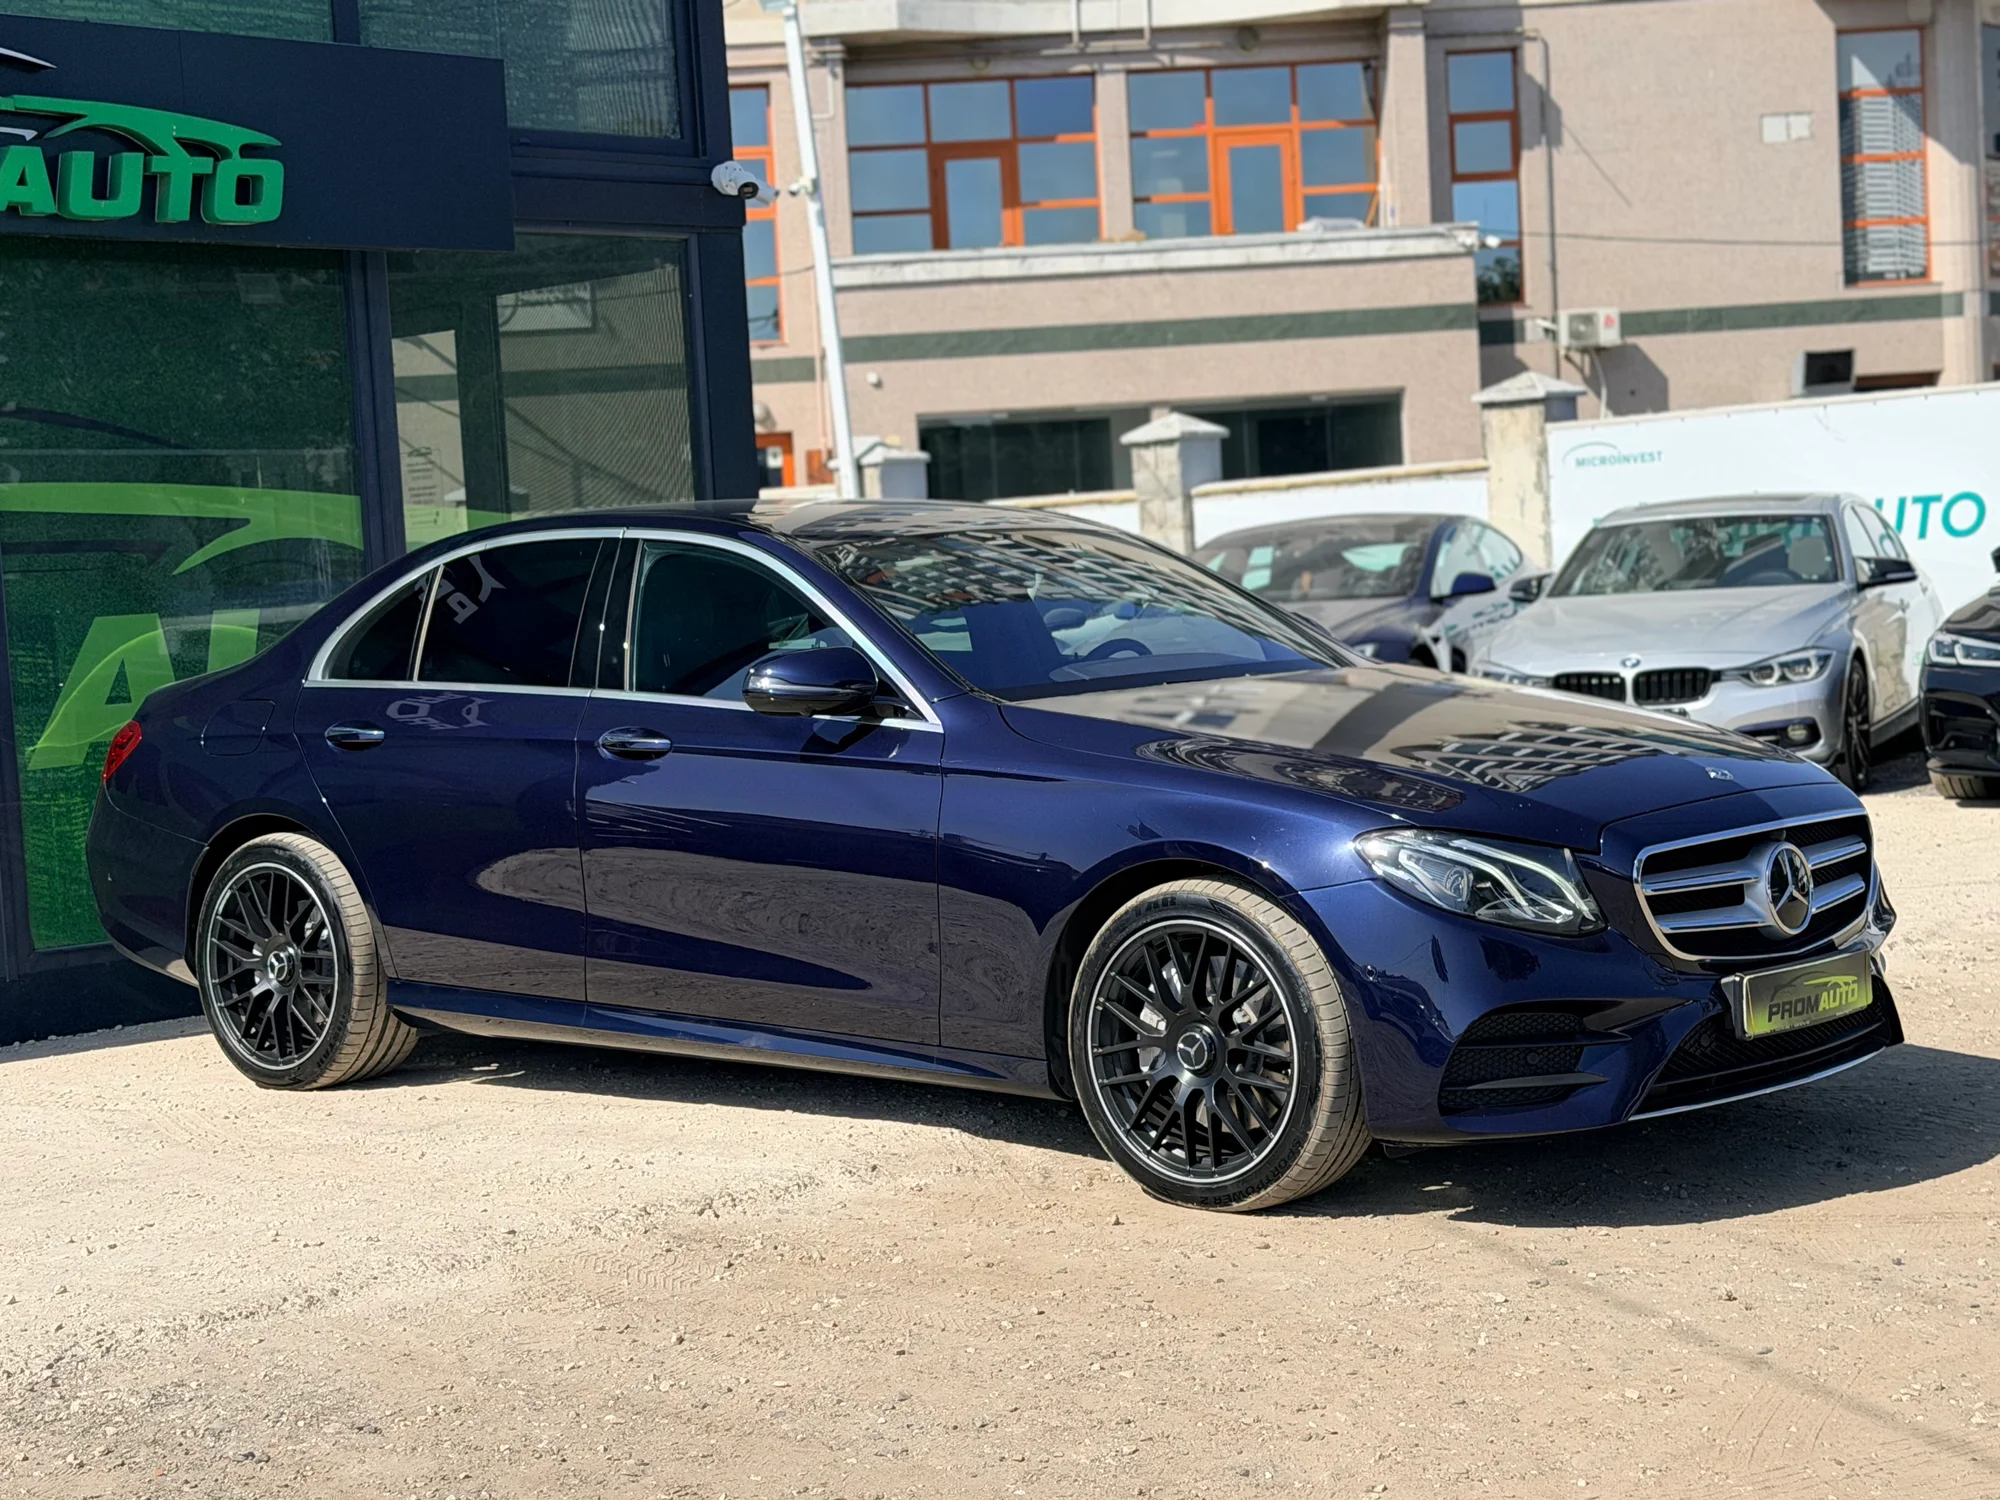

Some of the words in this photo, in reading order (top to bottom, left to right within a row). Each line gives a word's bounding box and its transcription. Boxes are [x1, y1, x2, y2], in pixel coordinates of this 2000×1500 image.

[0, 144, 285, 226] AUTO
[1576, 450, 1663, 467] MICROINVEST
[1875, 491, 1986, 540] UTO
[1767, 983, 1859, 1023] PROMAUTO
[1213, 1137, 1305, 1204] SPORTPOWER
